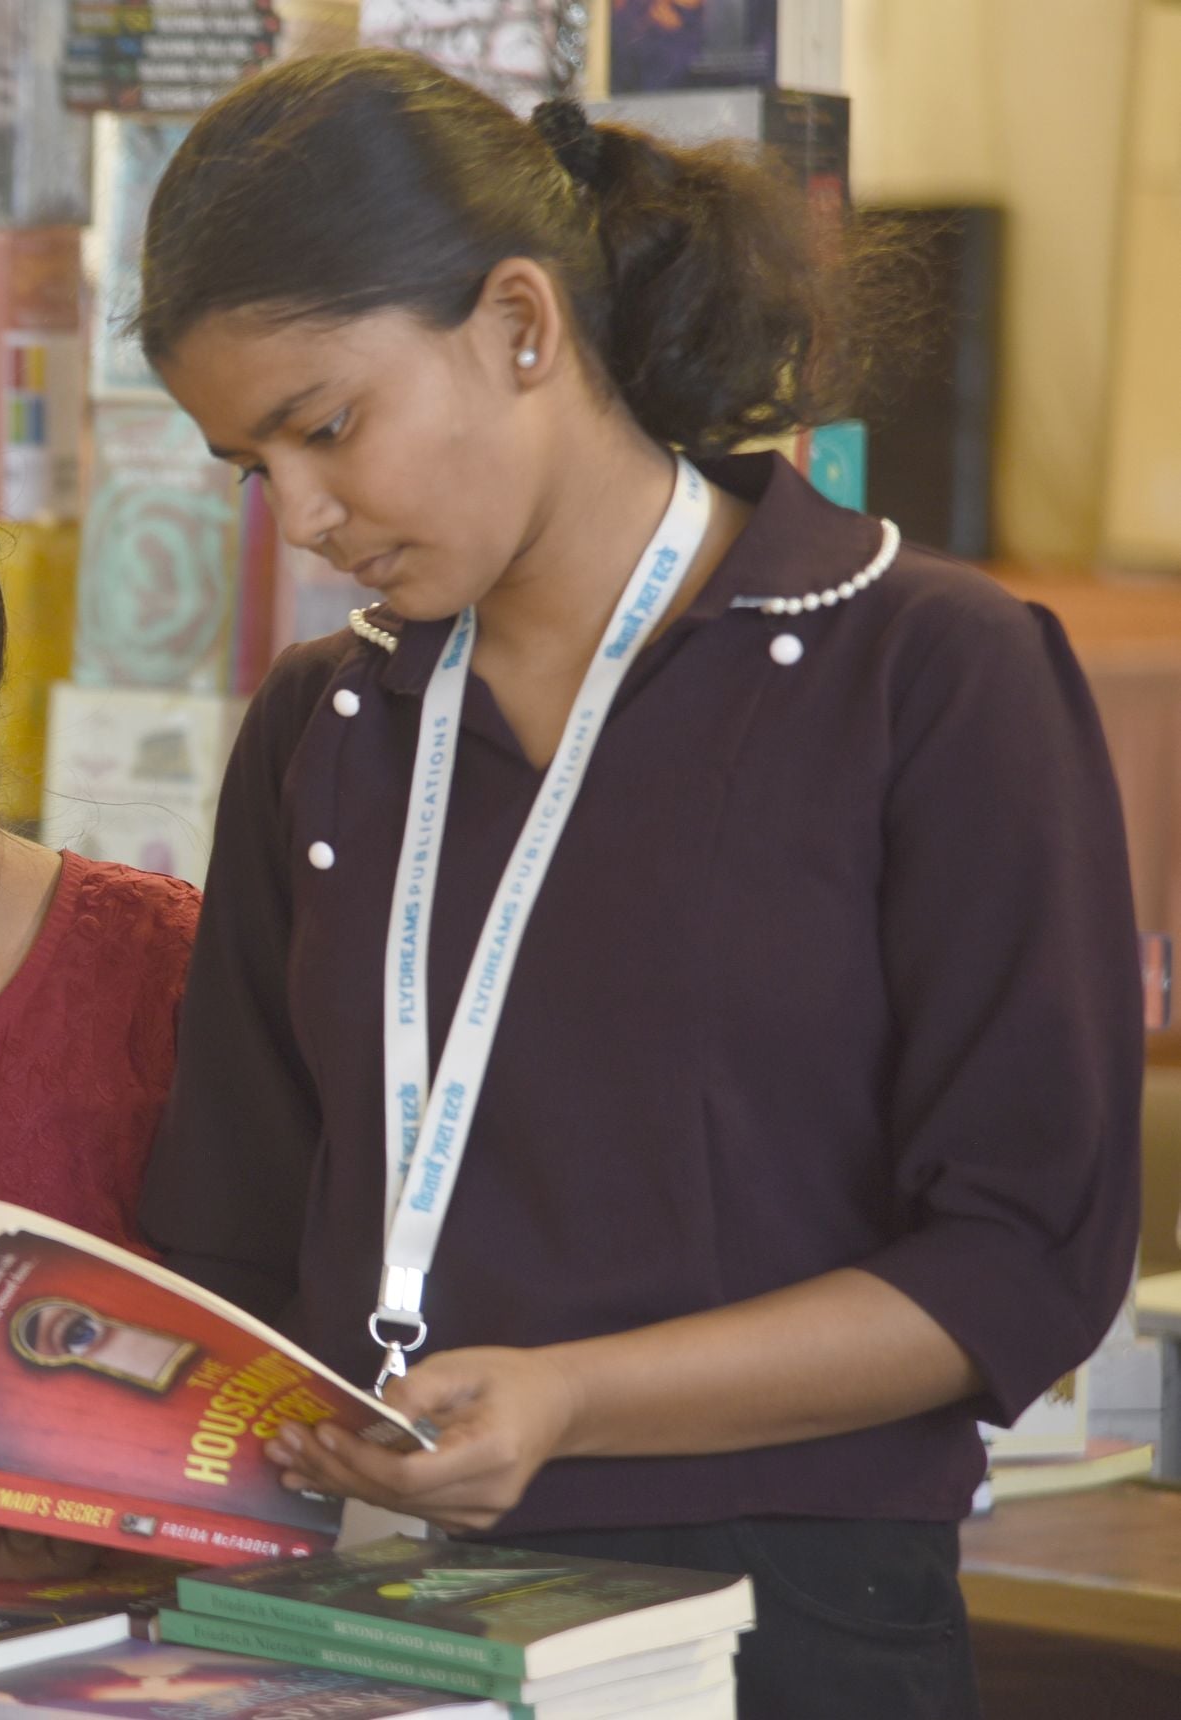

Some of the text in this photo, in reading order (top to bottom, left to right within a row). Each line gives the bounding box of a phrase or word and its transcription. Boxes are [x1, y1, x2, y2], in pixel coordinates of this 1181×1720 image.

[399, 715, 448, 1025] FLYDREAMS PUBLICATIONS
[467, 709, 595, 1027] FLYDREAMS PUBLICATIONS
[54, 1498, 117, 1530] SECRET
[160, 1521, 208, 1545] FREIDA
[212, 1532, 281, 1557] McFADDEN
[334, 1620, 383, 1641] BEYOND
[385, 1631, 424, 1649] GOOD
[427, 1640, 454, 1656] AND
[457, 1645, 488, 1663] EVIL
[321, 1649, 373, 1669] BEYOND
[375, 1659, 414, 1676] GOOD
[418, 1666, 446, 1682] AND
